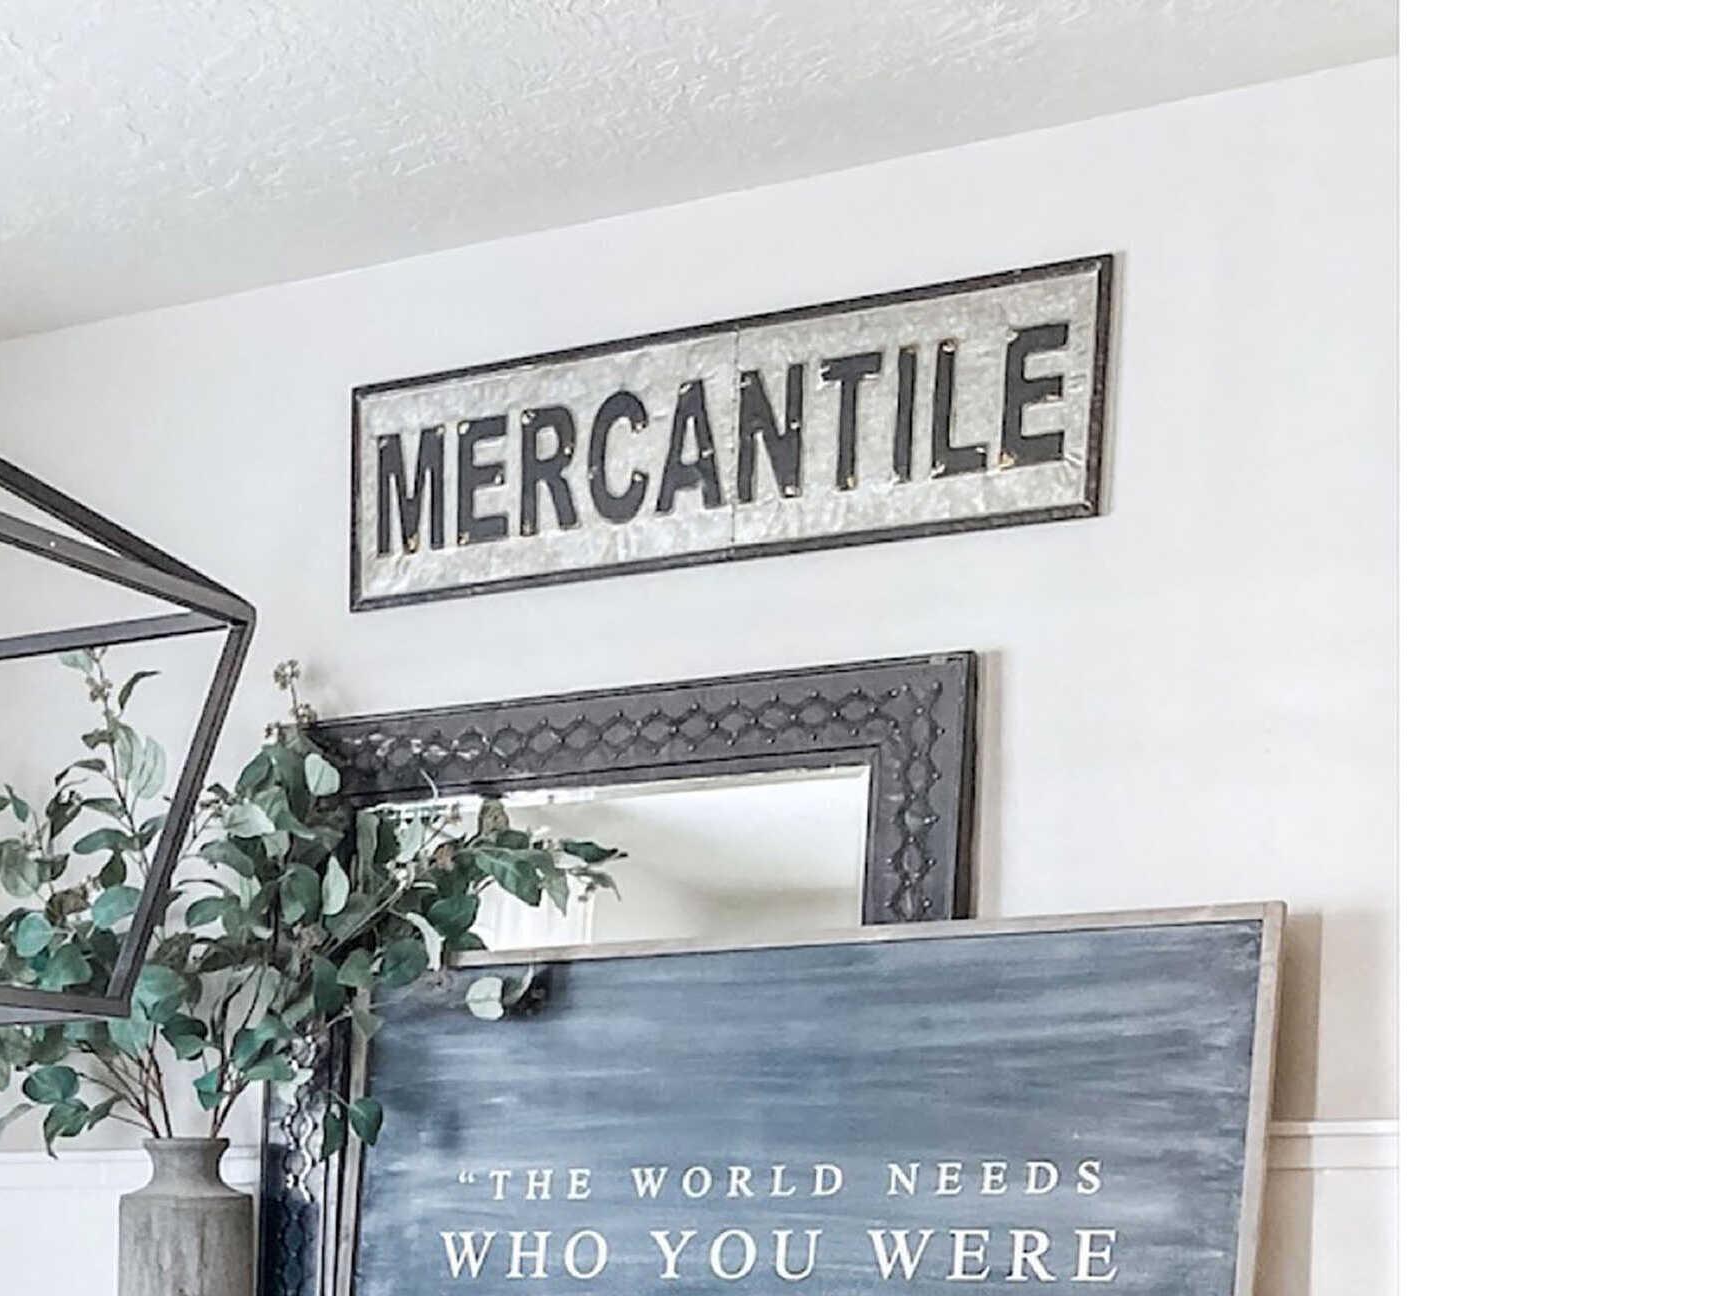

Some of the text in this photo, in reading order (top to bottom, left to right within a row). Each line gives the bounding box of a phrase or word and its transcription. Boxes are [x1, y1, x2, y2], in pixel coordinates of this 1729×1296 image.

[376, 323, 1069, 556] MERCANTILE
[632, 1164, 844, 1198] WORLD
[888, 1160, 1104, 1196] NEEDS
[441, 1228, 1119, 1283] WHO YOU WERE
